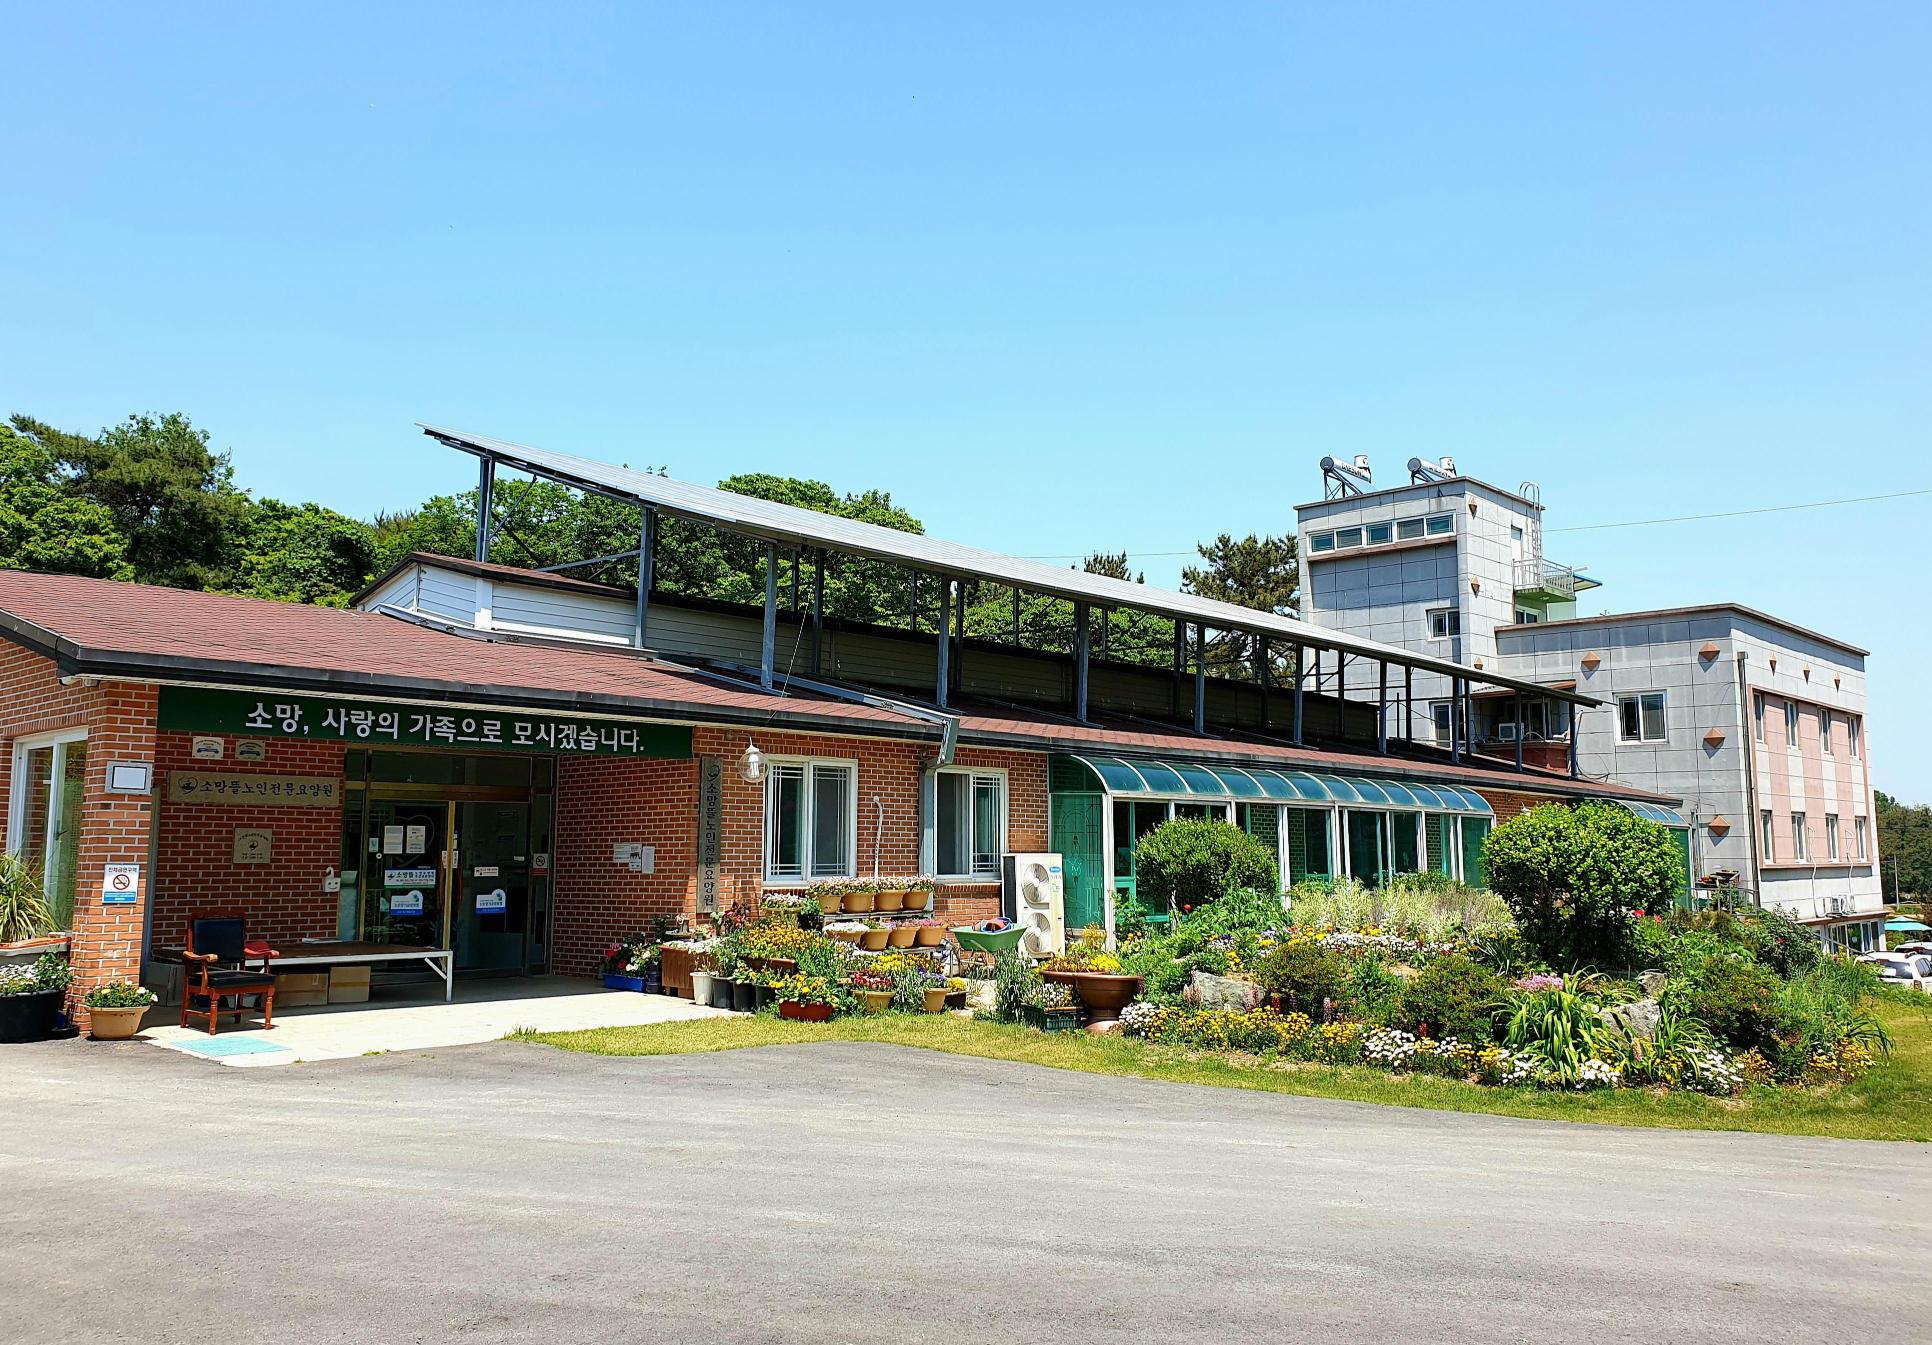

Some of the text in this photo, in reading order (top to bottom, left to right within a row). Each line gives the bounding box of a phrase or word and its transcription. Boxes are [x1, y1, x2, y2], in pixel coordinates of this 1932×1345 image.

[245, 702, 645, 753] 소망, 사랑의 가족으로 모시겠습니다.
